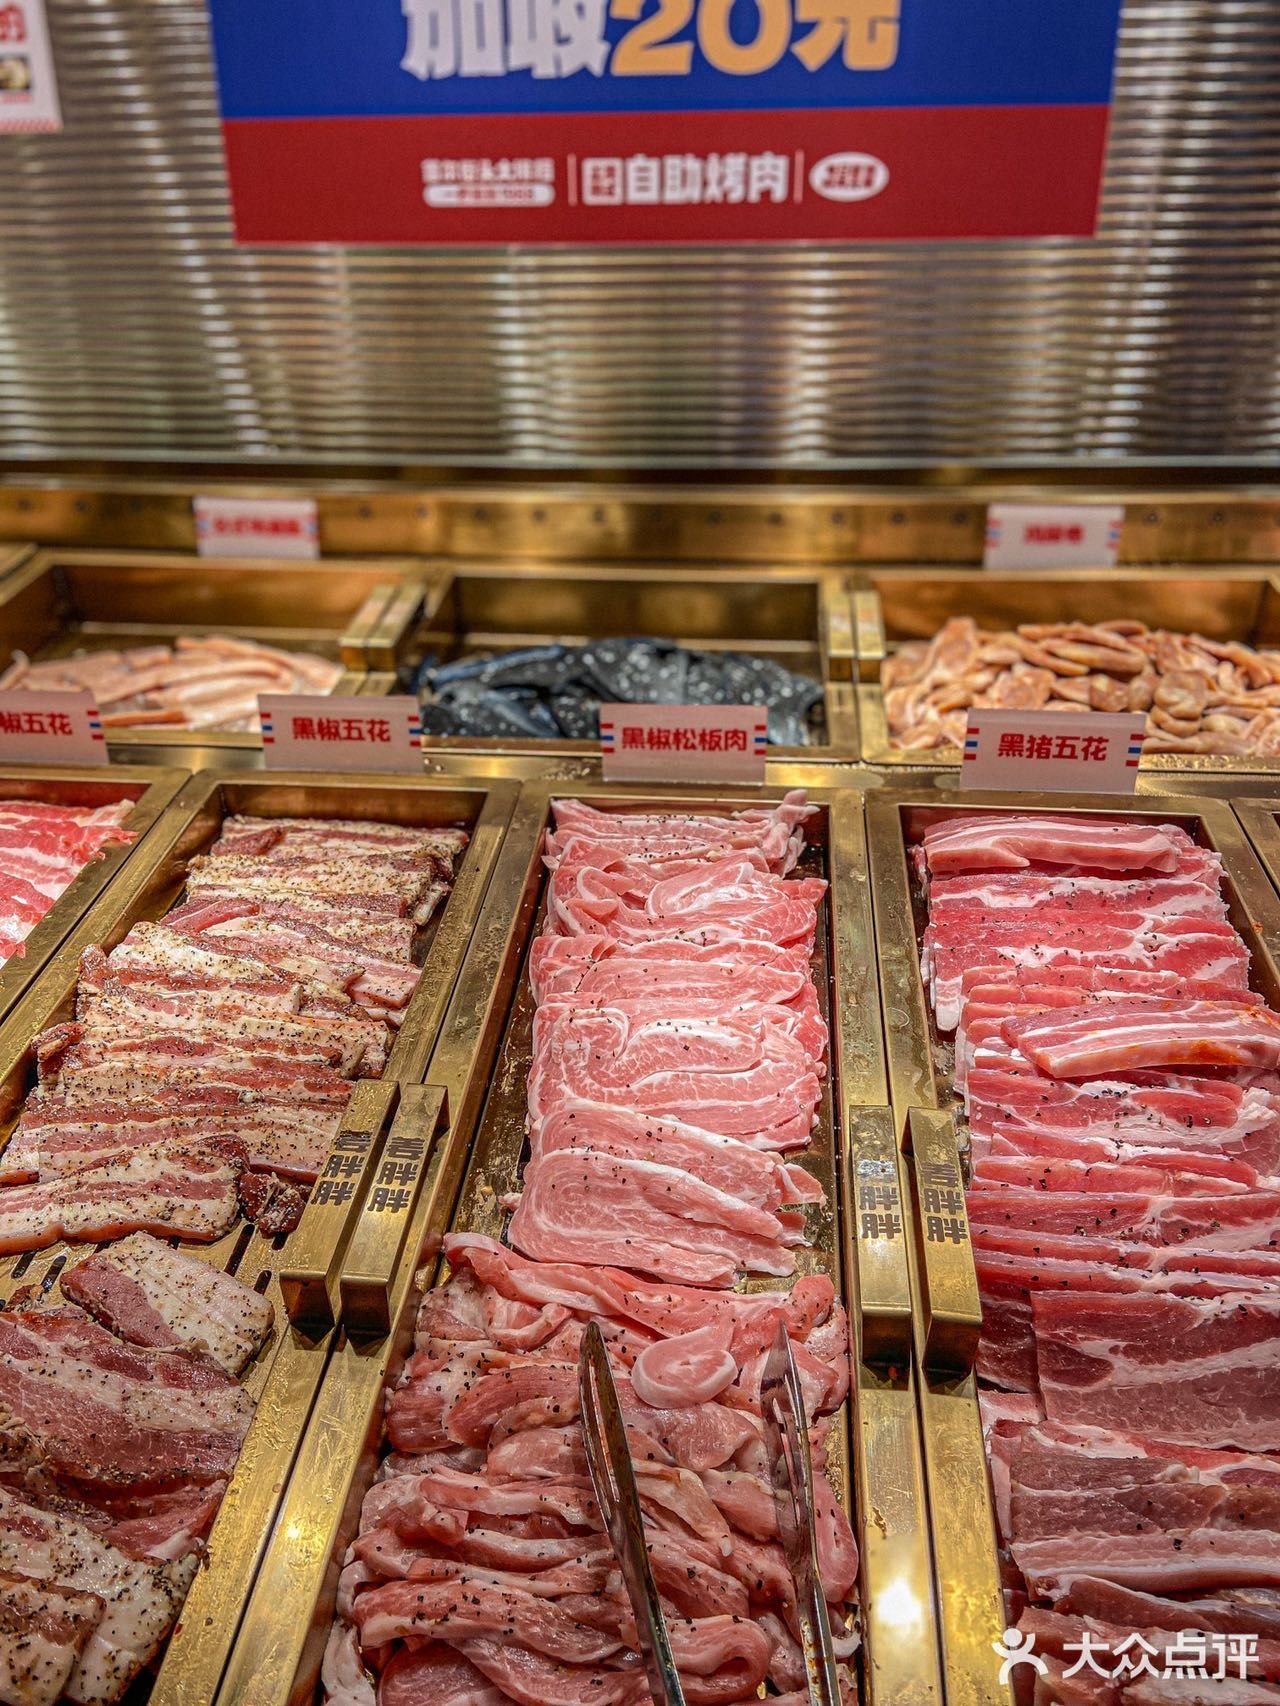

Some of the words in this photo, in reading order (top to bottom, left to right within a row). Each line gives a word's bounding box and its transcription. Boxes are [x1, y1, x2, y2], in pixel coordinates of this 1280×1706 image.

[291, 716, 392, 743] 黑椒五花
[621, 727, 748, 752] 黑椒松板肉
[998, 733, 1110, 762] 黑猪五花
